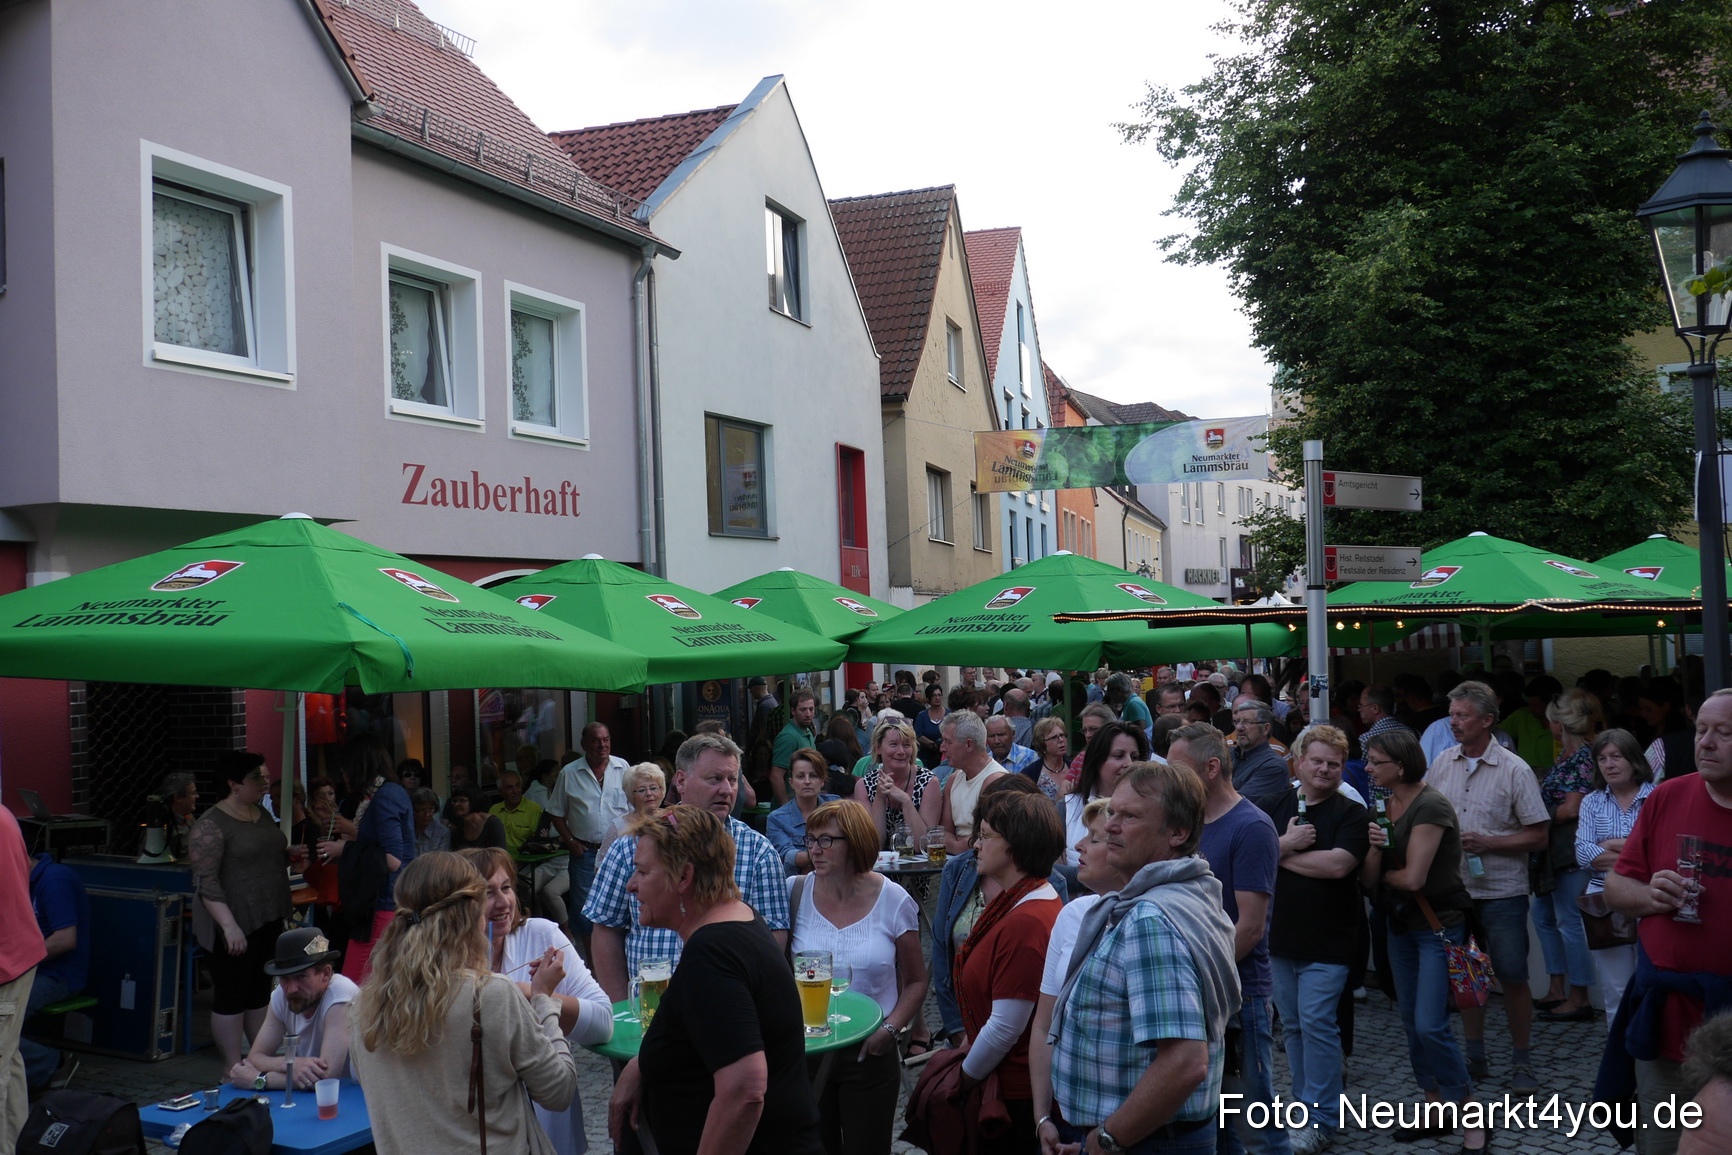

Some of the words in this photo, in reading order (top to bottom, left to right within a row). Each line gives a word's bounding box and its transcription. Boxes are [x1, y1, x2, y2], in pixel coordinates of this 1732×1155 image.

[1191, 452, 1240, 462] Neumarkter
[1183, 461, 1249, 473] Lammsbräu
[401, 462, 581, 518] Zauberhaft
[1338, 480, 1378, 490] Amtsgericht
[1354, 554, 1385, 562] Reitstadel
[1366, 567, 1378, 575] der
[1378, 567, 1406, 575] Residenz
[70, 597, 226, 612] Neumarkter
[12, 610, 229, 628] Lammsbräu
[946, 612, 1030, 623] Neumarkter
[671, 622, 746, 634] Neumarkter
[914, 622, 1031, 636] Lammsbräu
[671, 631, 778, 648] Lammsbräu
